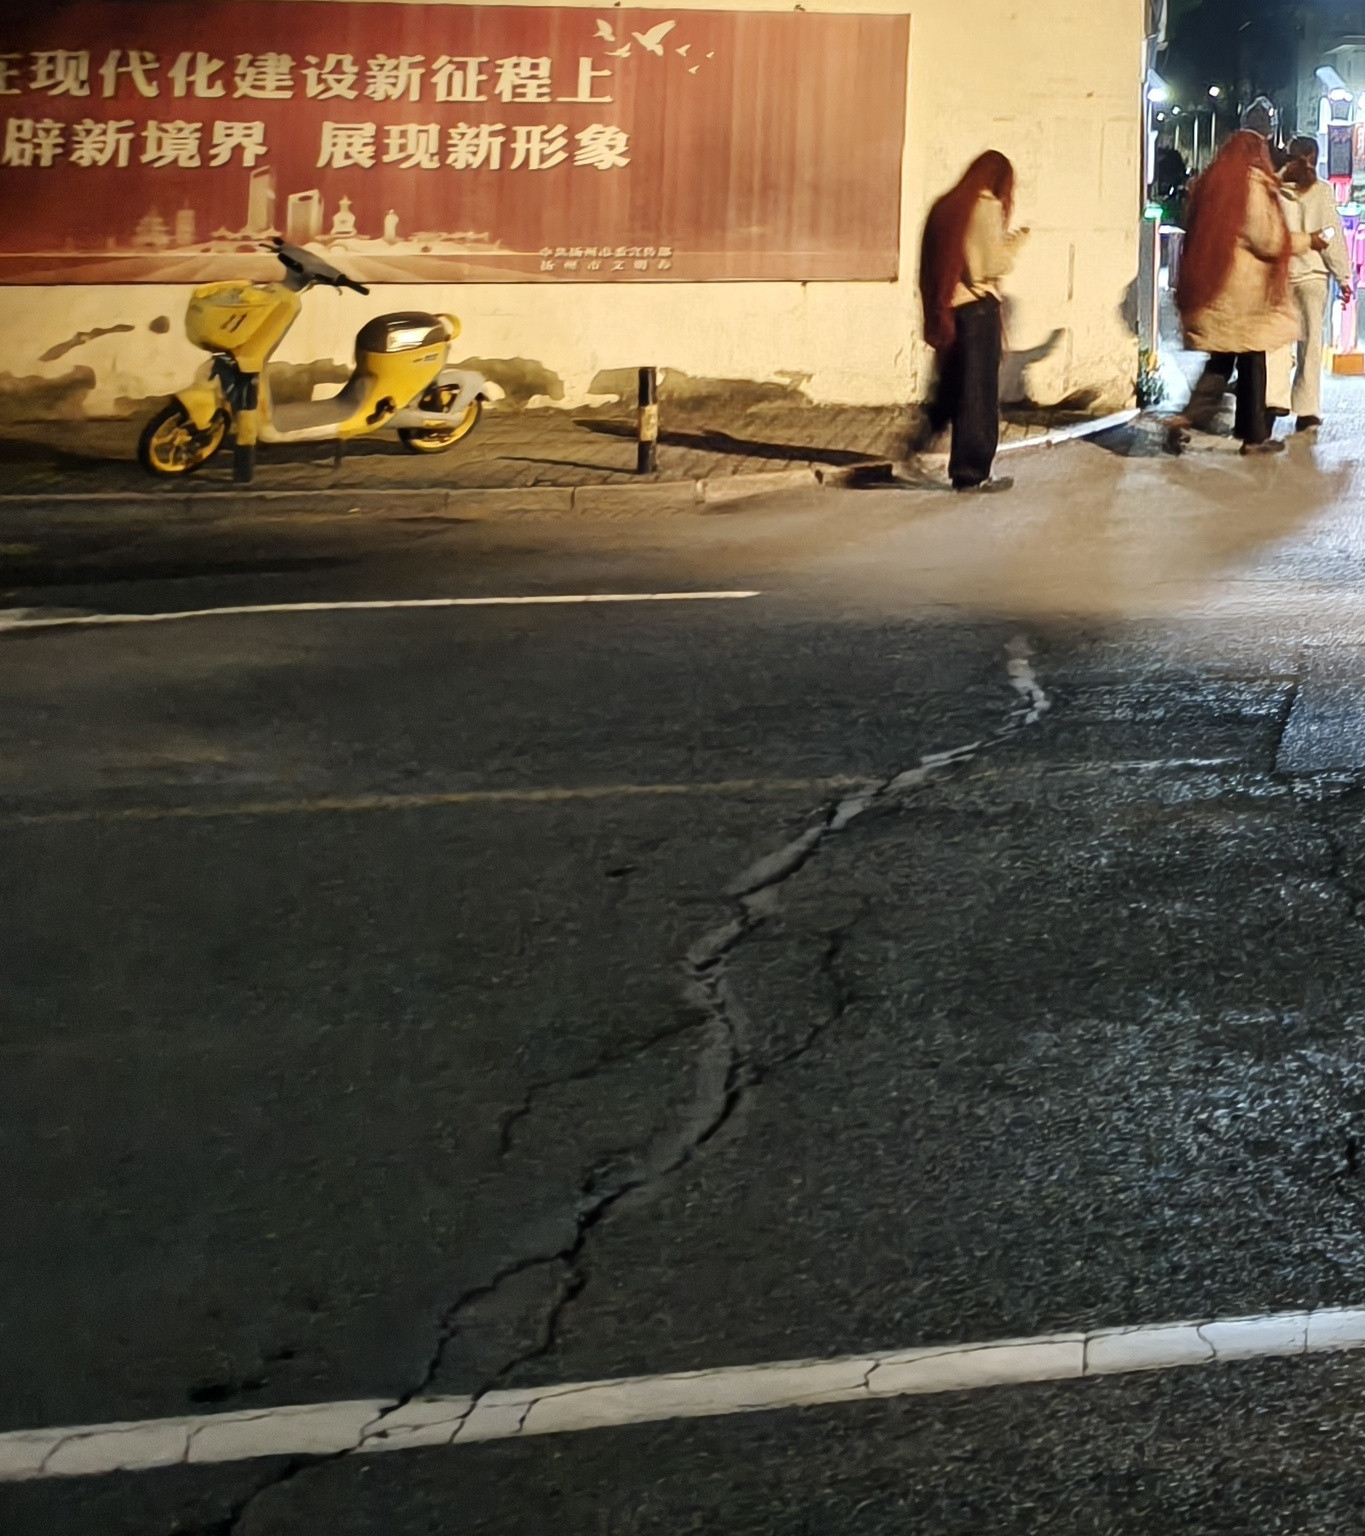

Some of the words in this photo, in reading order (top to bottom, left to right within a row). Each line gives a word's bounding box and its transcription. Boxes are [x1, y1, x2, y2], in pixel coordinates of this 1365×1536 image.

[2, 117, 269, 168] 辟新境界
[317, 121, 632, 170] 展现新形象
